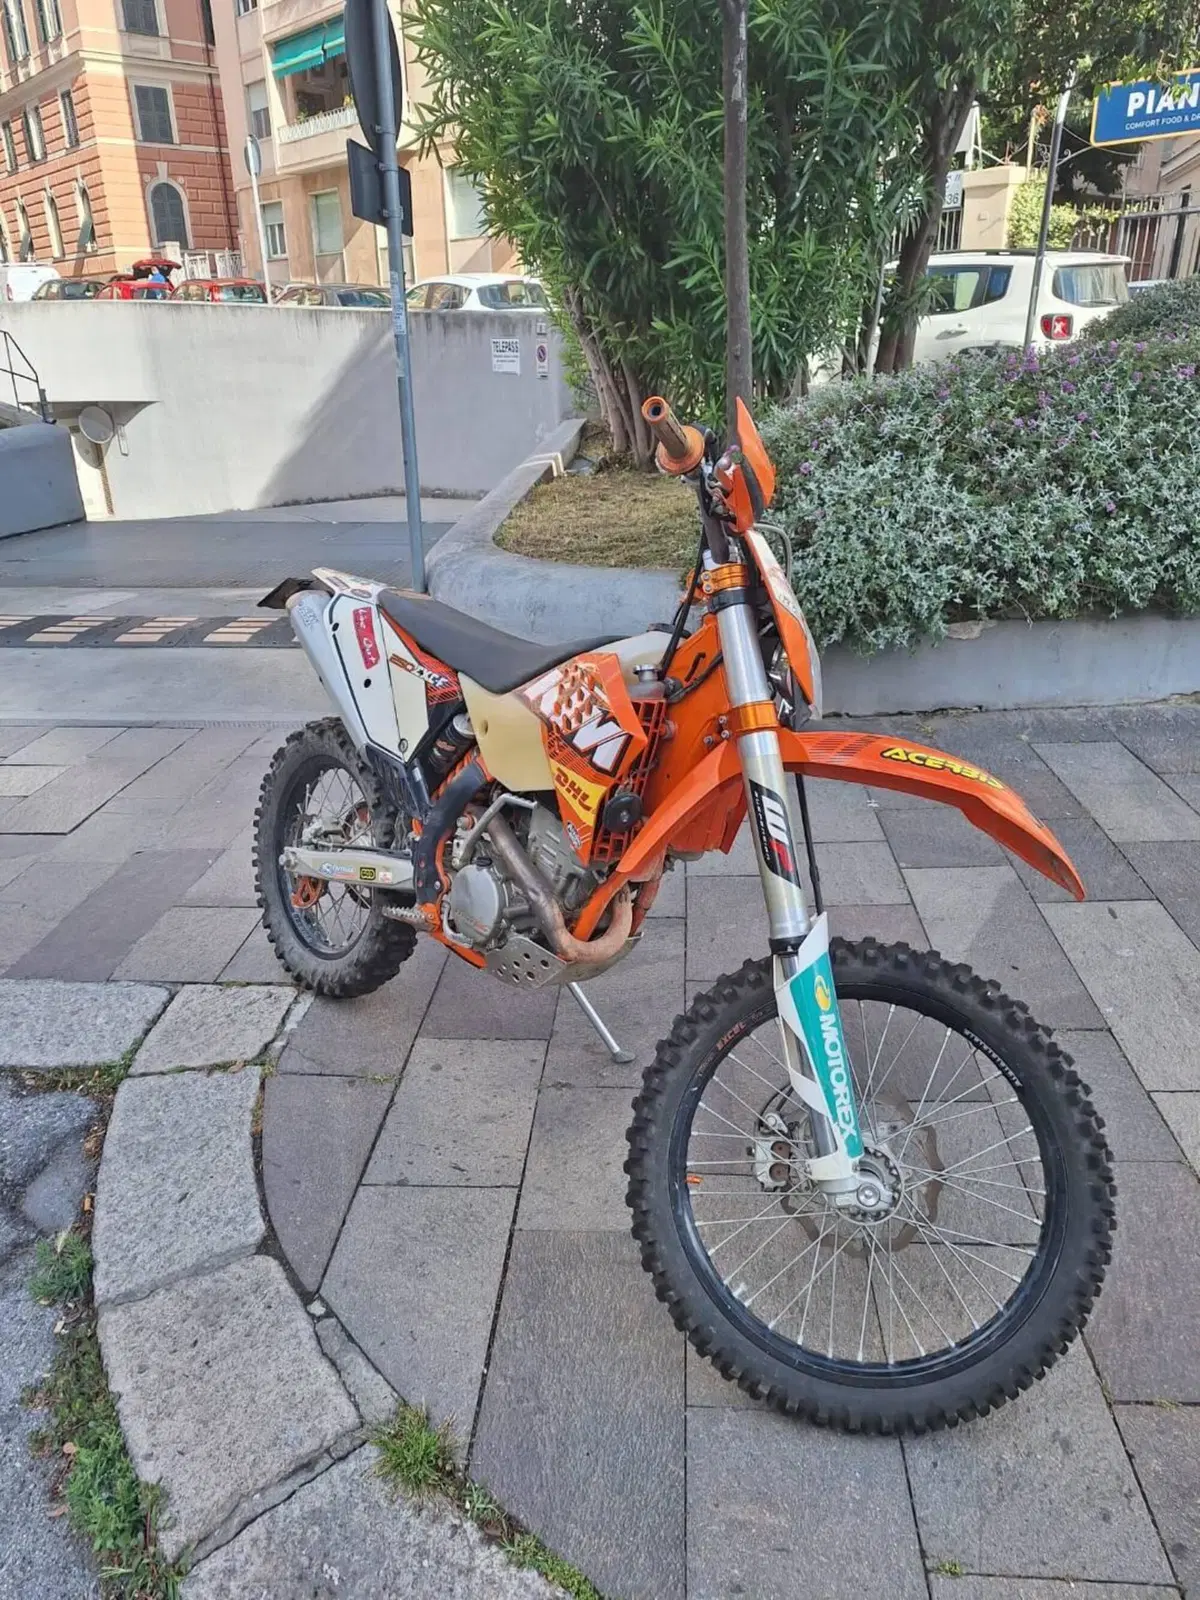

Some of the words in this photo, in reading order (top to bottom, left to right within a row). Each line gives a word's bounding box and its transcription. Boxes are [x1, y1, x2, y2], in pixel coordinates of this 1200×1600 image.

[1125, 119, 1160, 131] COMFORT
[1161, 115, 1183, 126] FOOD
[492, 340, 519, 353] TELEPASS
[554, 766, 593, 813] DHL
[880, 747, 1005, 790] ACERBIS
[818, 1012, 859, 1142] MOTOREX
